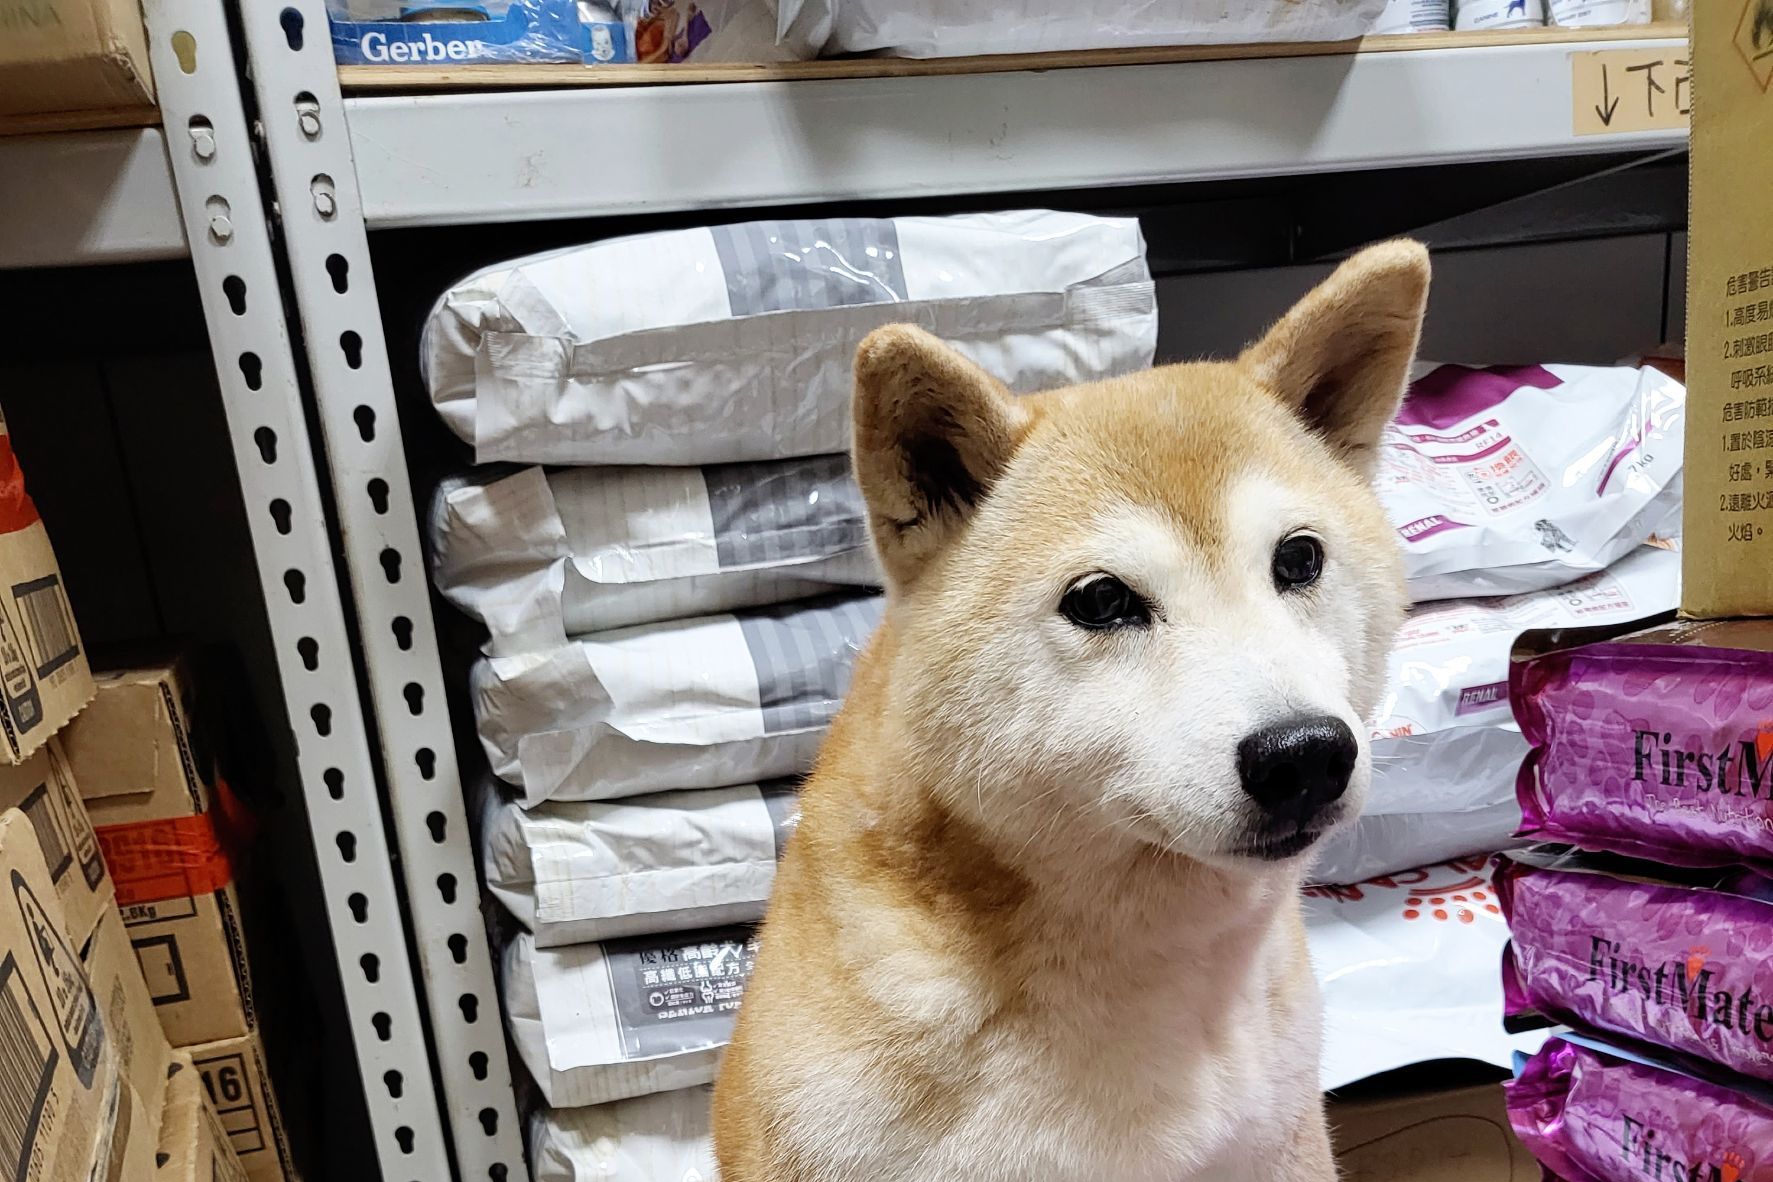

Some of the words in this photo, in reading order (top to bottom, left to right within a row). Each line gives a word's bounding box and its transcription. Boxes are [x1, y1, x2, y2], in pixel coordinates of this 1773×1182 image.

[361, 32, 483, 62] Gerber
[1726, 267, 1773, 297] 危害警告
